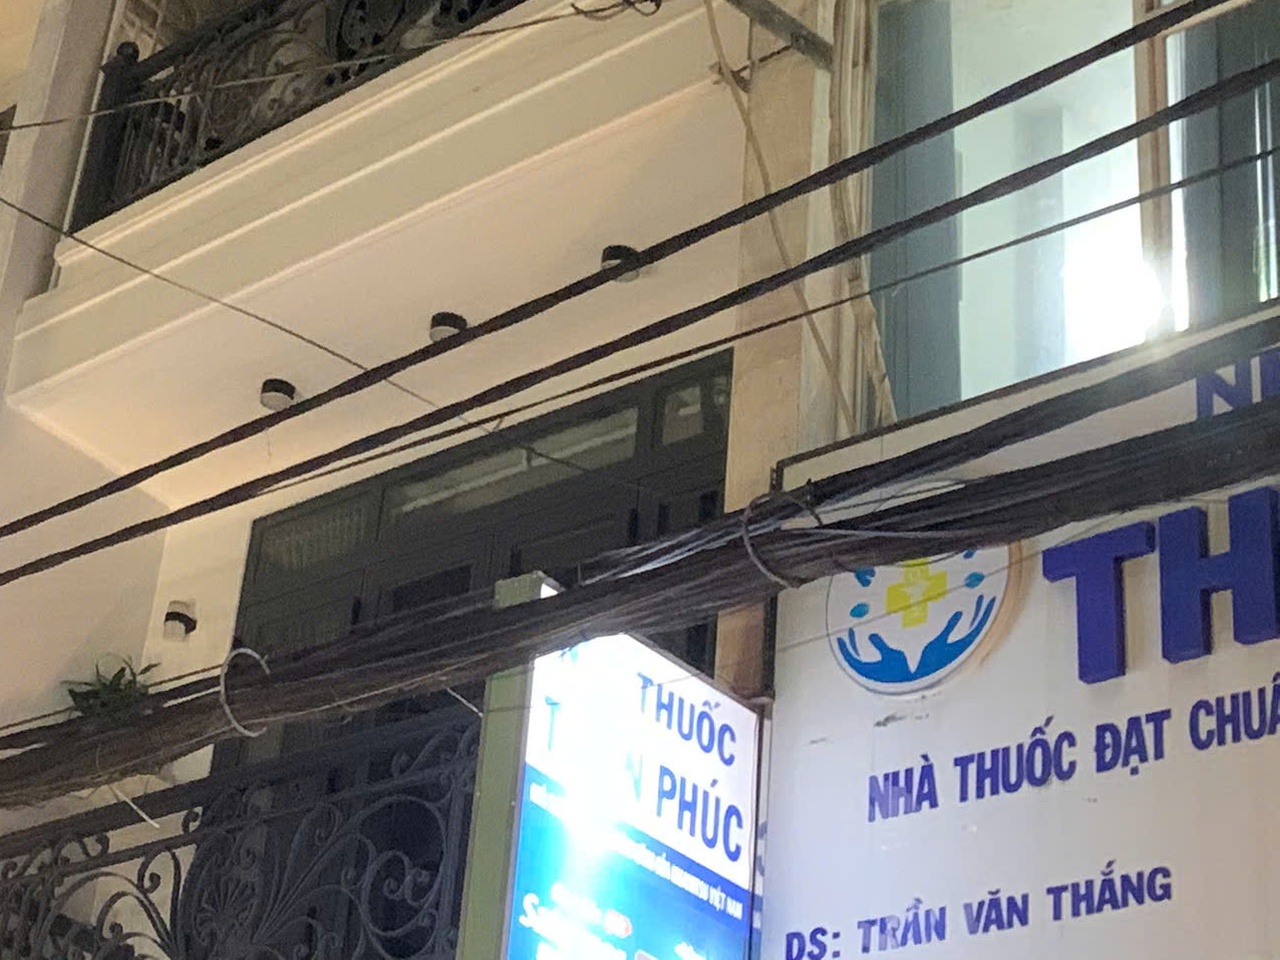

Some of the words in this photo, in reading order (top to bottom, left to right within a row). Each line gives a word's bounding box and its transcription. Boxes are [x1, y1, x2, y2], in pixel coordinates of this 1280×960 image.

[1042, 485, 1280, 685] TH
[636, 672, 737, 767] THUỐC
[868, 755, 939, 823] NHÀ
[954, 716, 1078, 803] THUỐC
[1095, 709, 1172, 776] ĐẠT
[656, 764, 744, 863] PHÚC
[785, 926, 841, 960] DS:
[857, 897, 947, 954] TRẦN
[964, 888, 1029, 936] VĂN
[1047, 859, 1173, 922] THẮNG
